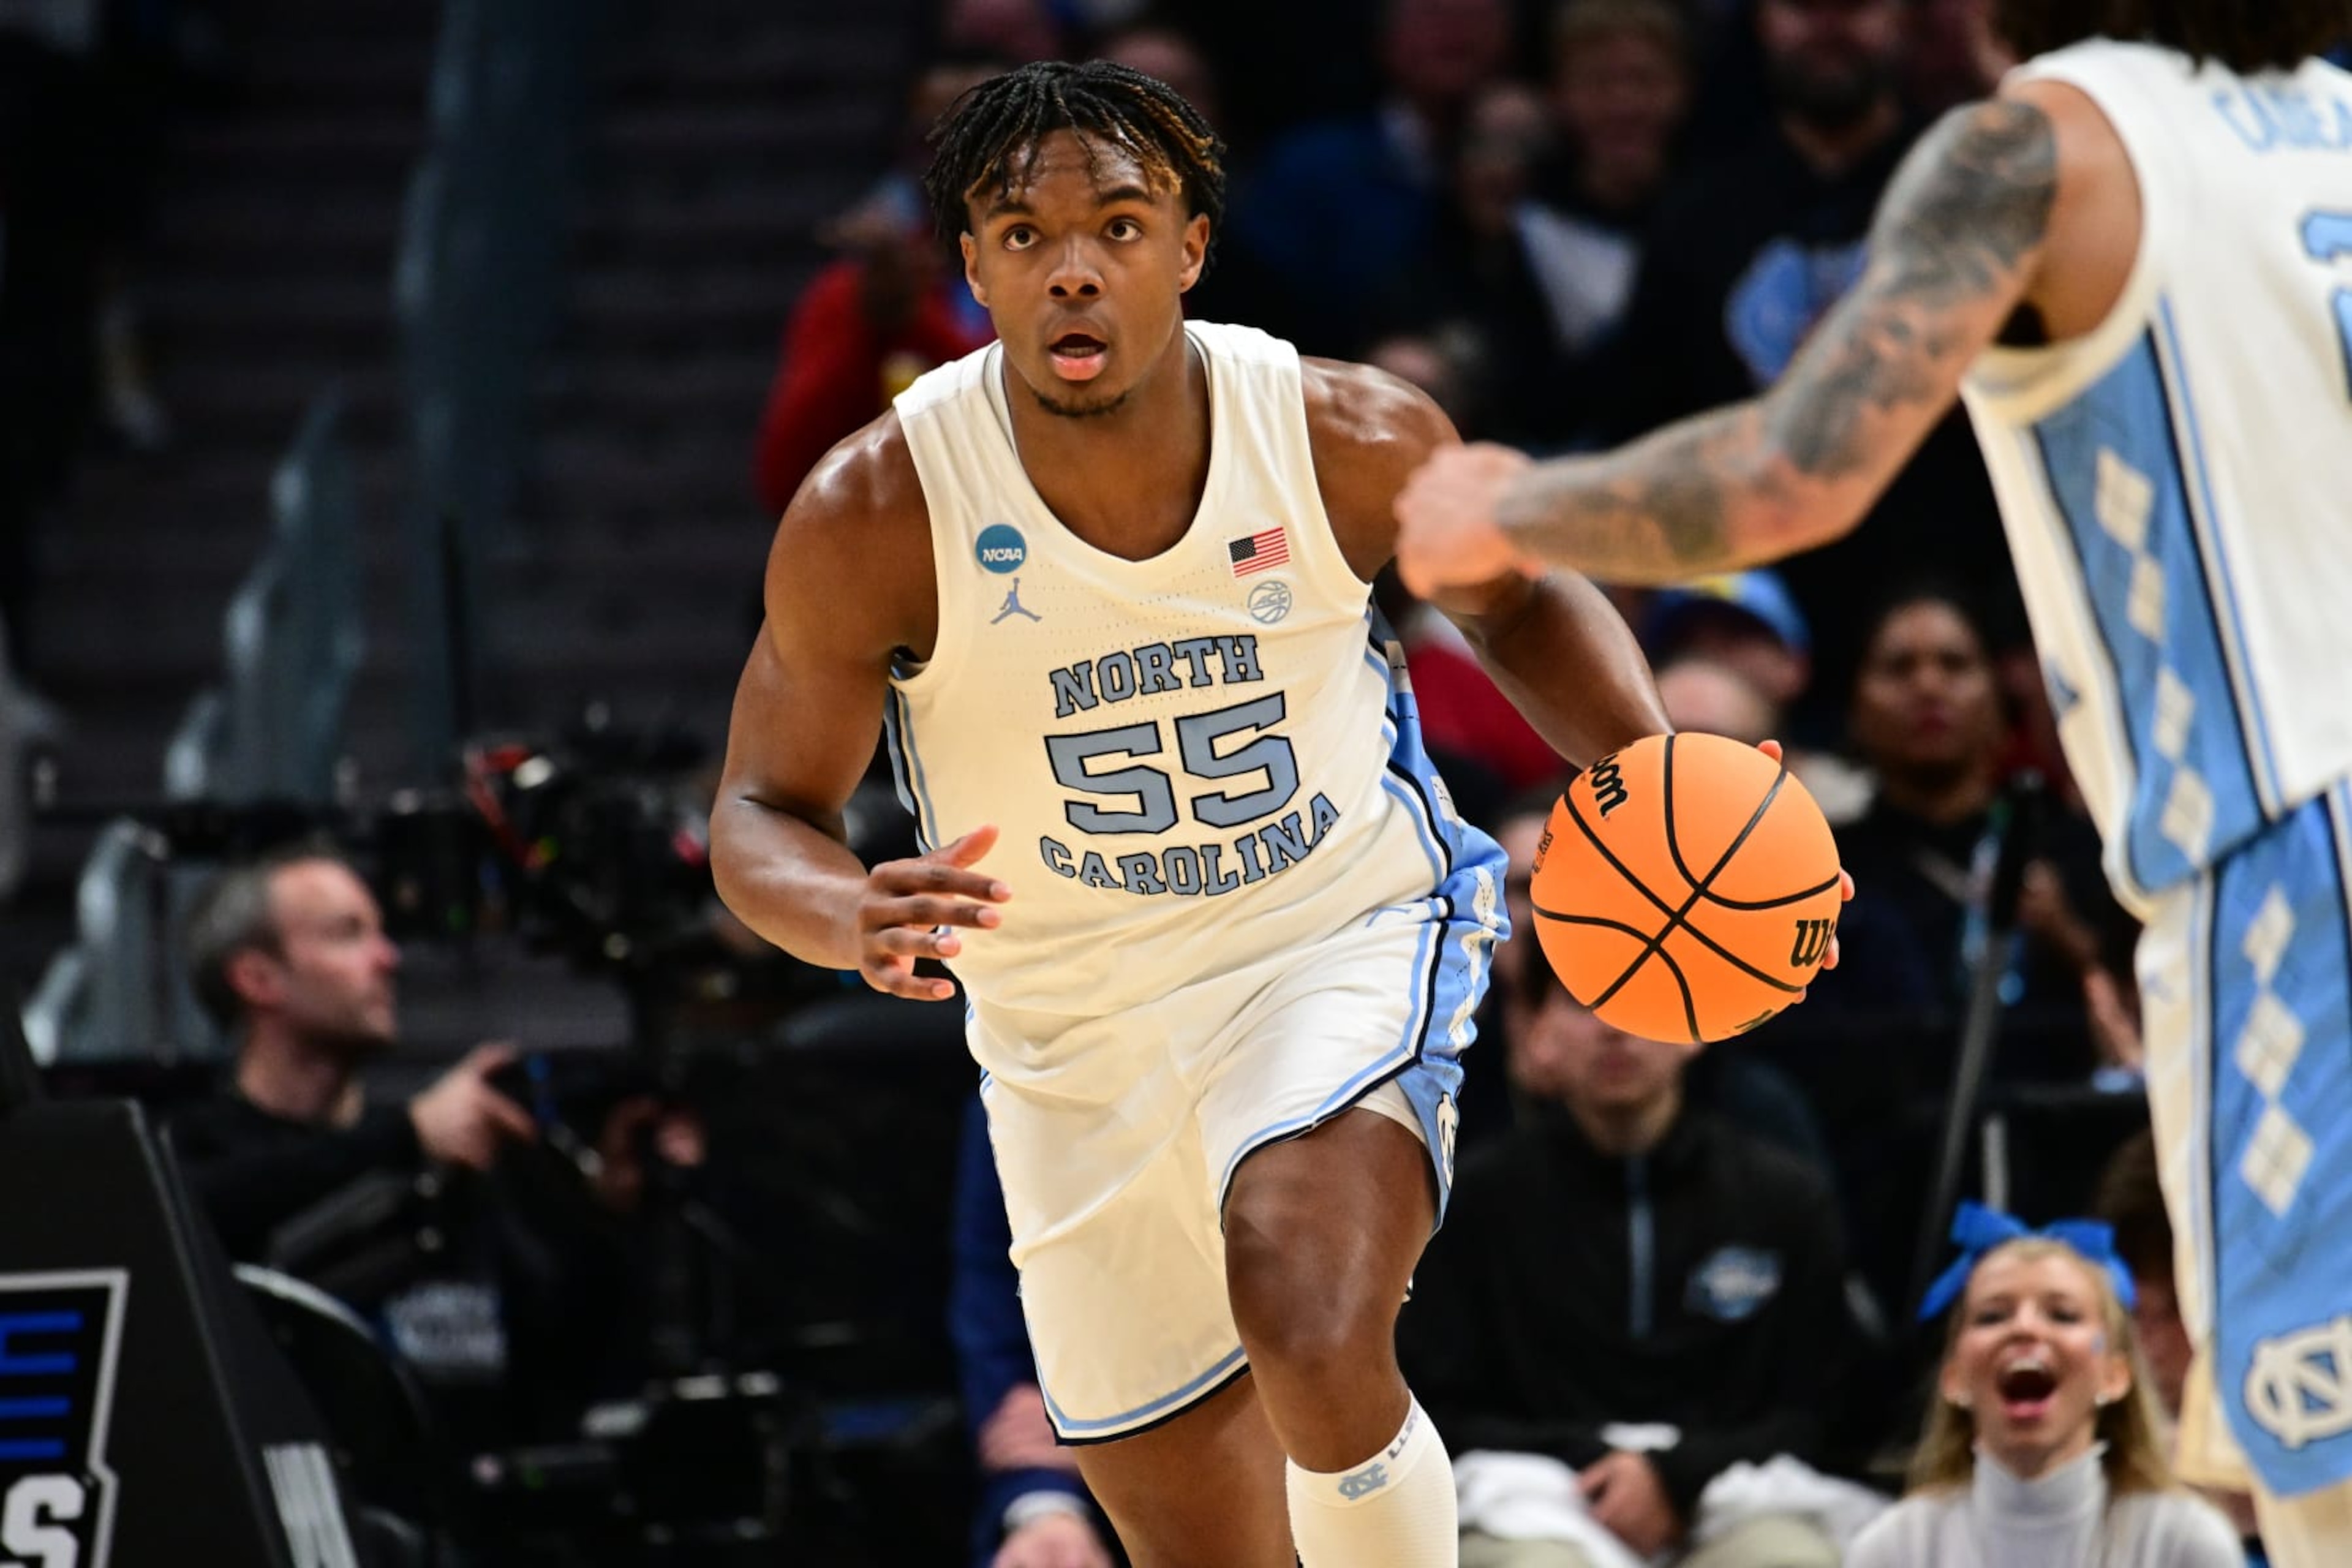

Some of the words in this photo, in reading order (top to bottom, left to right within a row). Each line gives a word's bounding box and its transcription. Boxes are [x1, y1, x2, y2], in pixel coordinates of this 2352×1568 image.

[982, 548, 1023, 562] NCAA
[1049, 635, 1264, 718] NORTH
[1044, 690, 1300, 834] 55
[1040, 792, 1340, 896] CAROLINA
